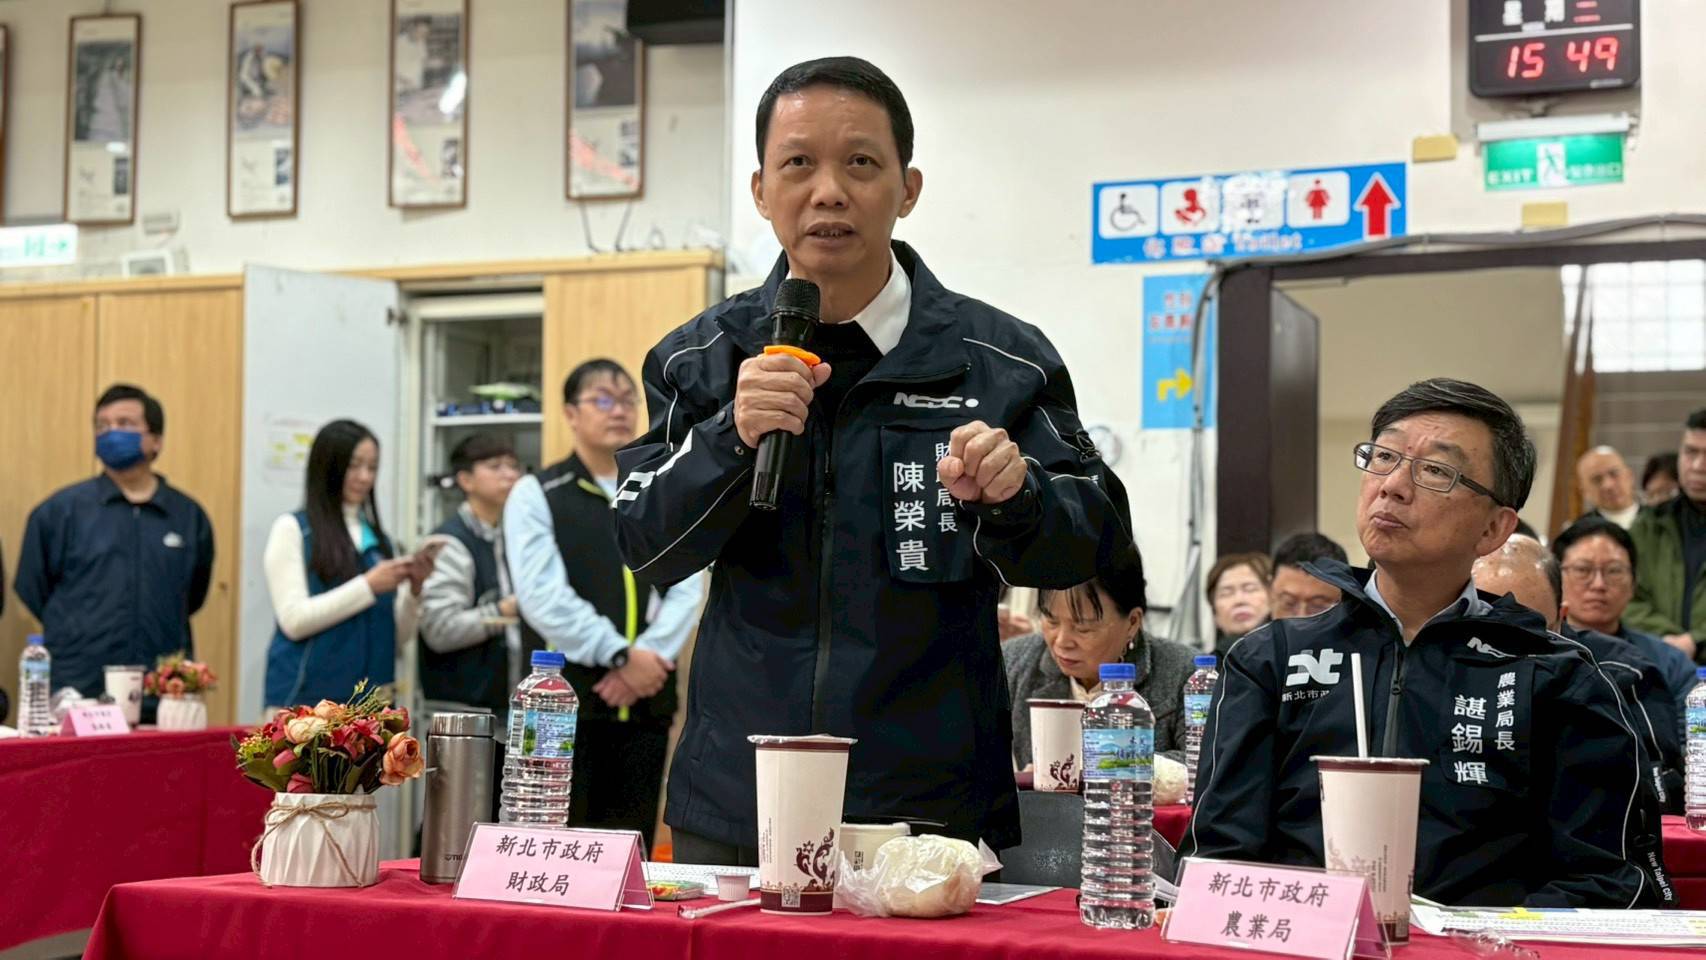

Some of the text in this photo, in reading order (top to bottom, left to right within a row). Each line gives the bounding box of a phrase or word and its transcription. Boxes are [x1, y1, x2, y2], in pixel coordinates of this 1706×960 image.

[1507, 36, 1620, 79] 15 49
[935, 442, 958, 533] 財局長
[893, 461, 929, 572] 陳榮貴
[1494, 671, 1516, 751] 農業局長
[1451, 694, 1488, 784] 諶錫輝
[496, 834, 604, 864] 新北市政府
[505, 870, 570, 896] 財政局
[1208, 871, 1330, 908] 新北市政府
[1648, 851, 1673, 901] New Taipei City
[1220, 910, 1292, 943] 農業局
